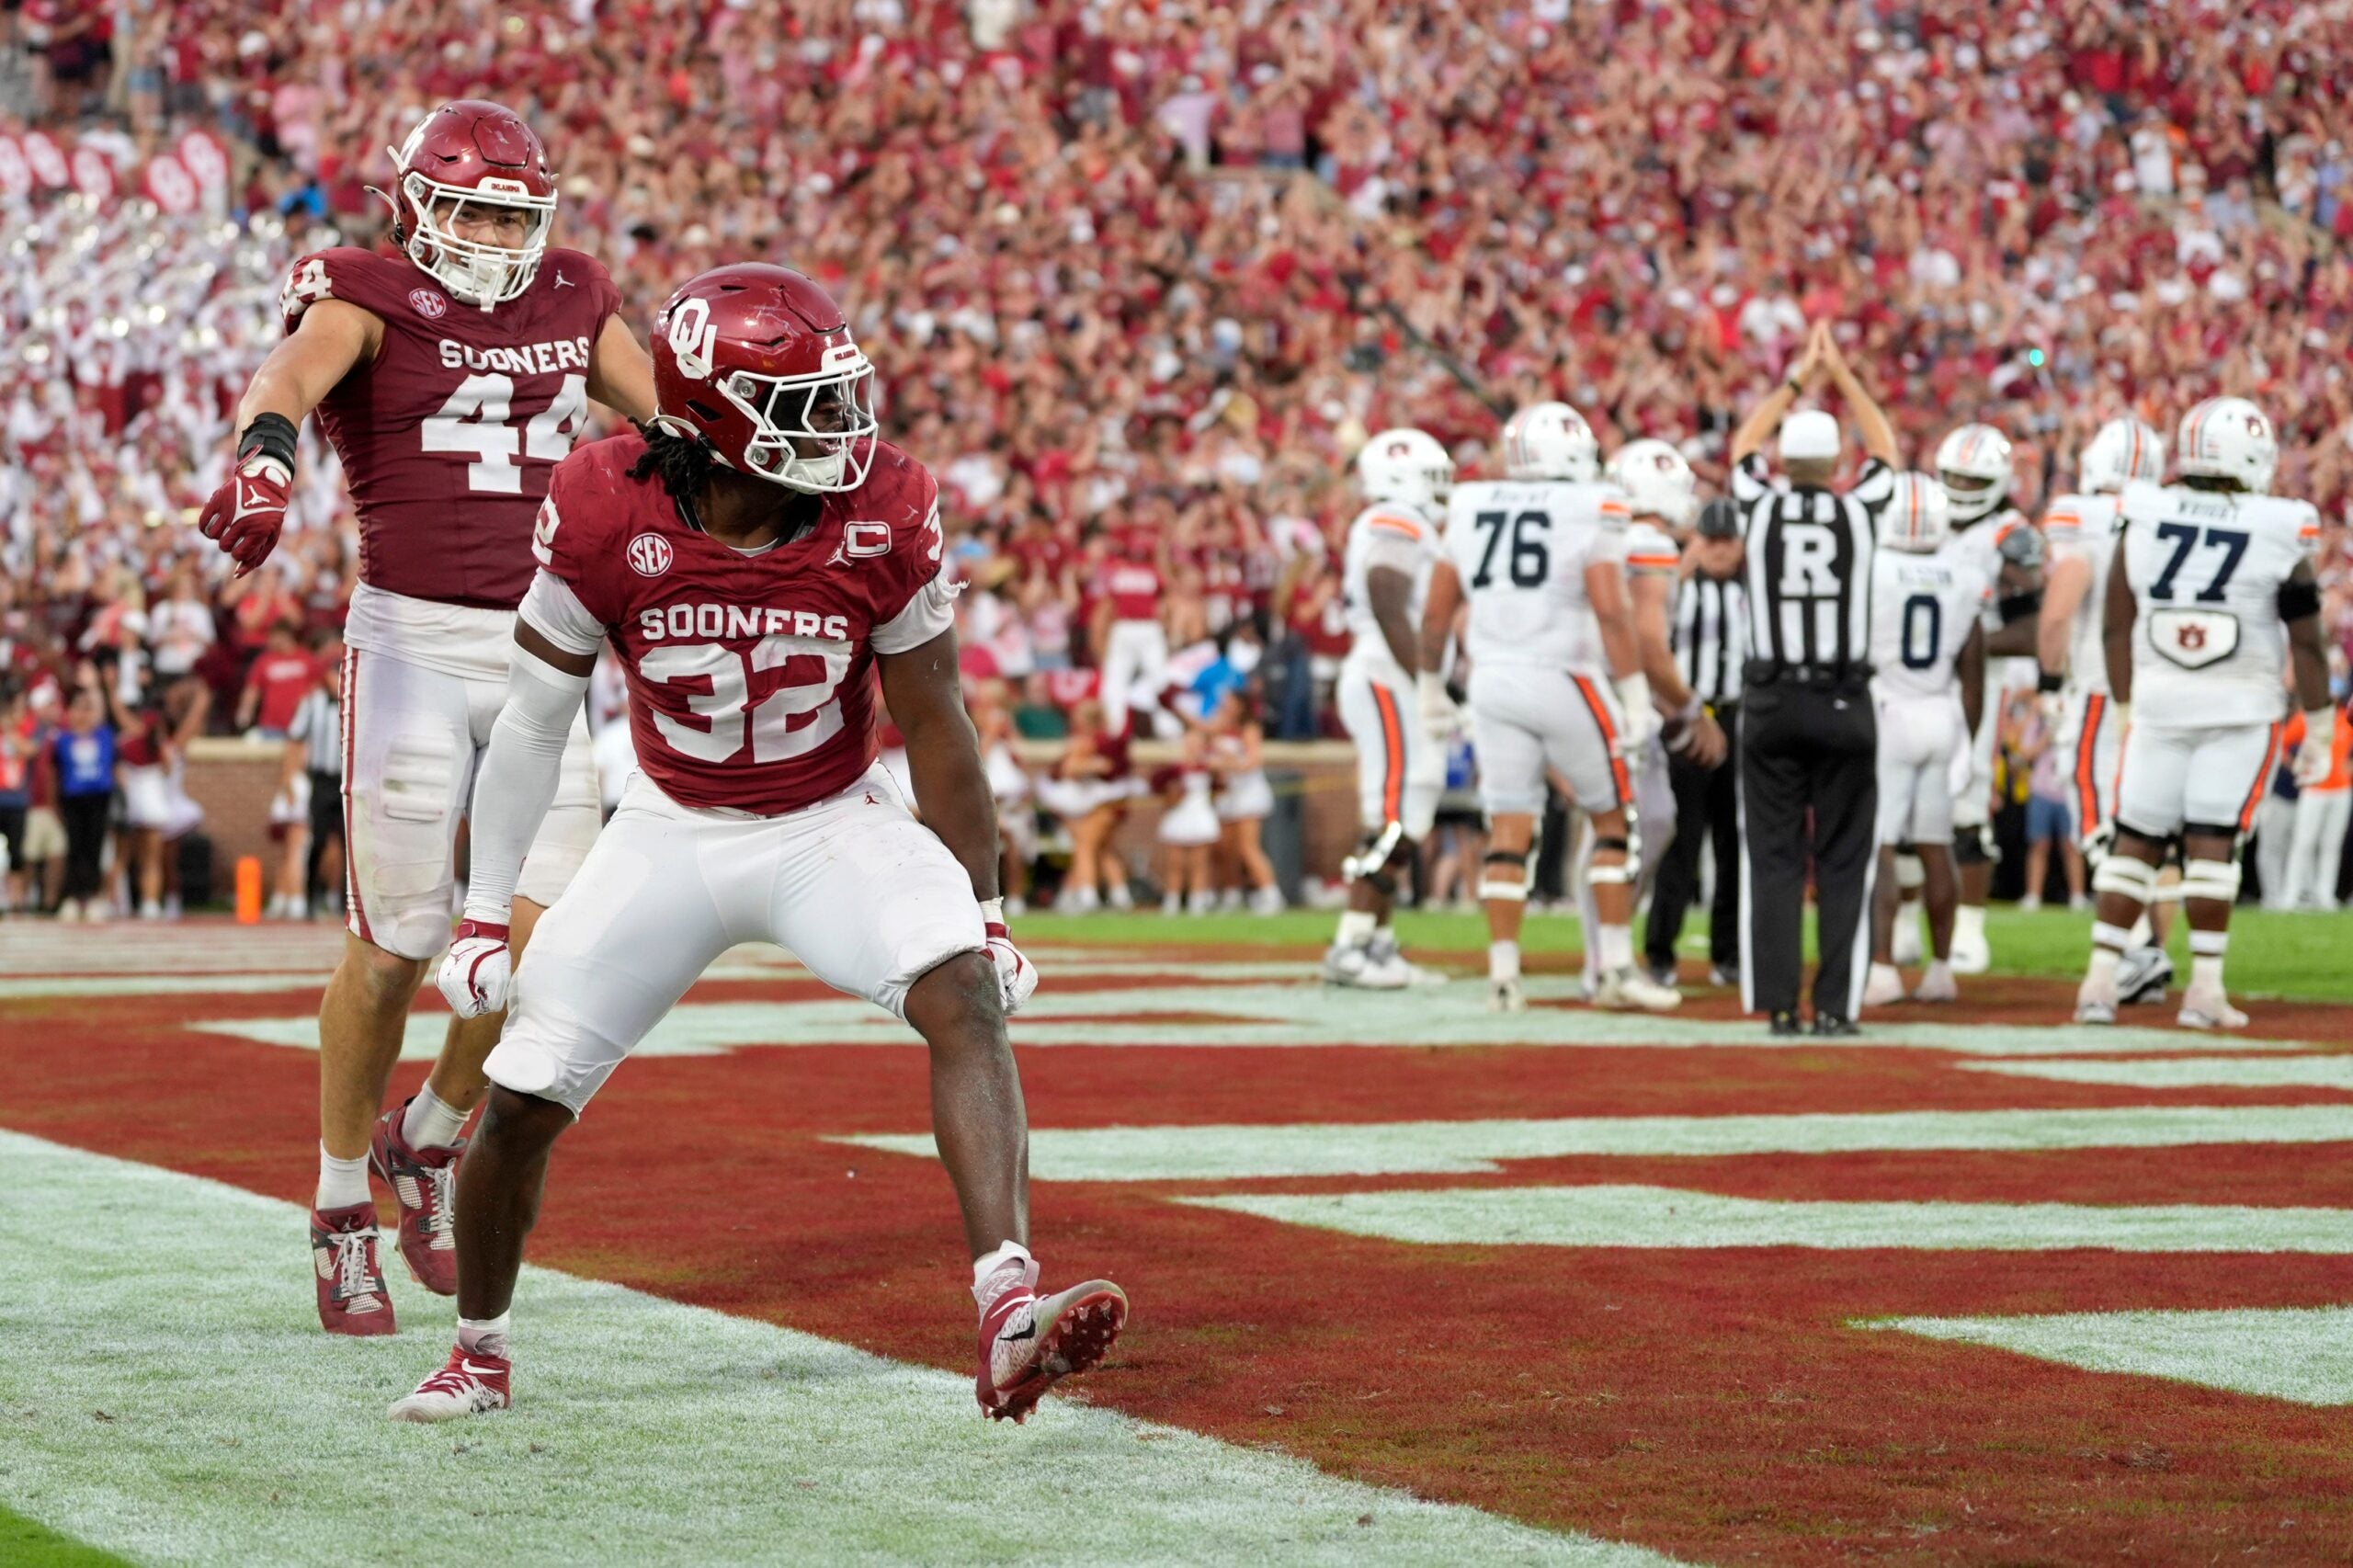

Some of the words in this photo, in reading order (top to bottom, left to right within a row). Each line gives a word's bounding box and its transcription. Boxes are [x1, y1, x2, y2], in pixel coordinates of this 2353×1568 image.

[412, 290, 444, 316] SEC
[439, 336, 589, 375] SOONERS
[421, 372, 588, 494] 44
[631, 535, 669, 574] SEC
[847, 525, 888, 552] C
[1472, 511, 1552, 588] 76
[1779, 524, 1842, 597] R
[2149, 522, 2250, 601] 77
[640, 603, 848, 642] SOONERS
[1902, 595, 1940, 669] 0
[639, 634, 853, 764] 32
